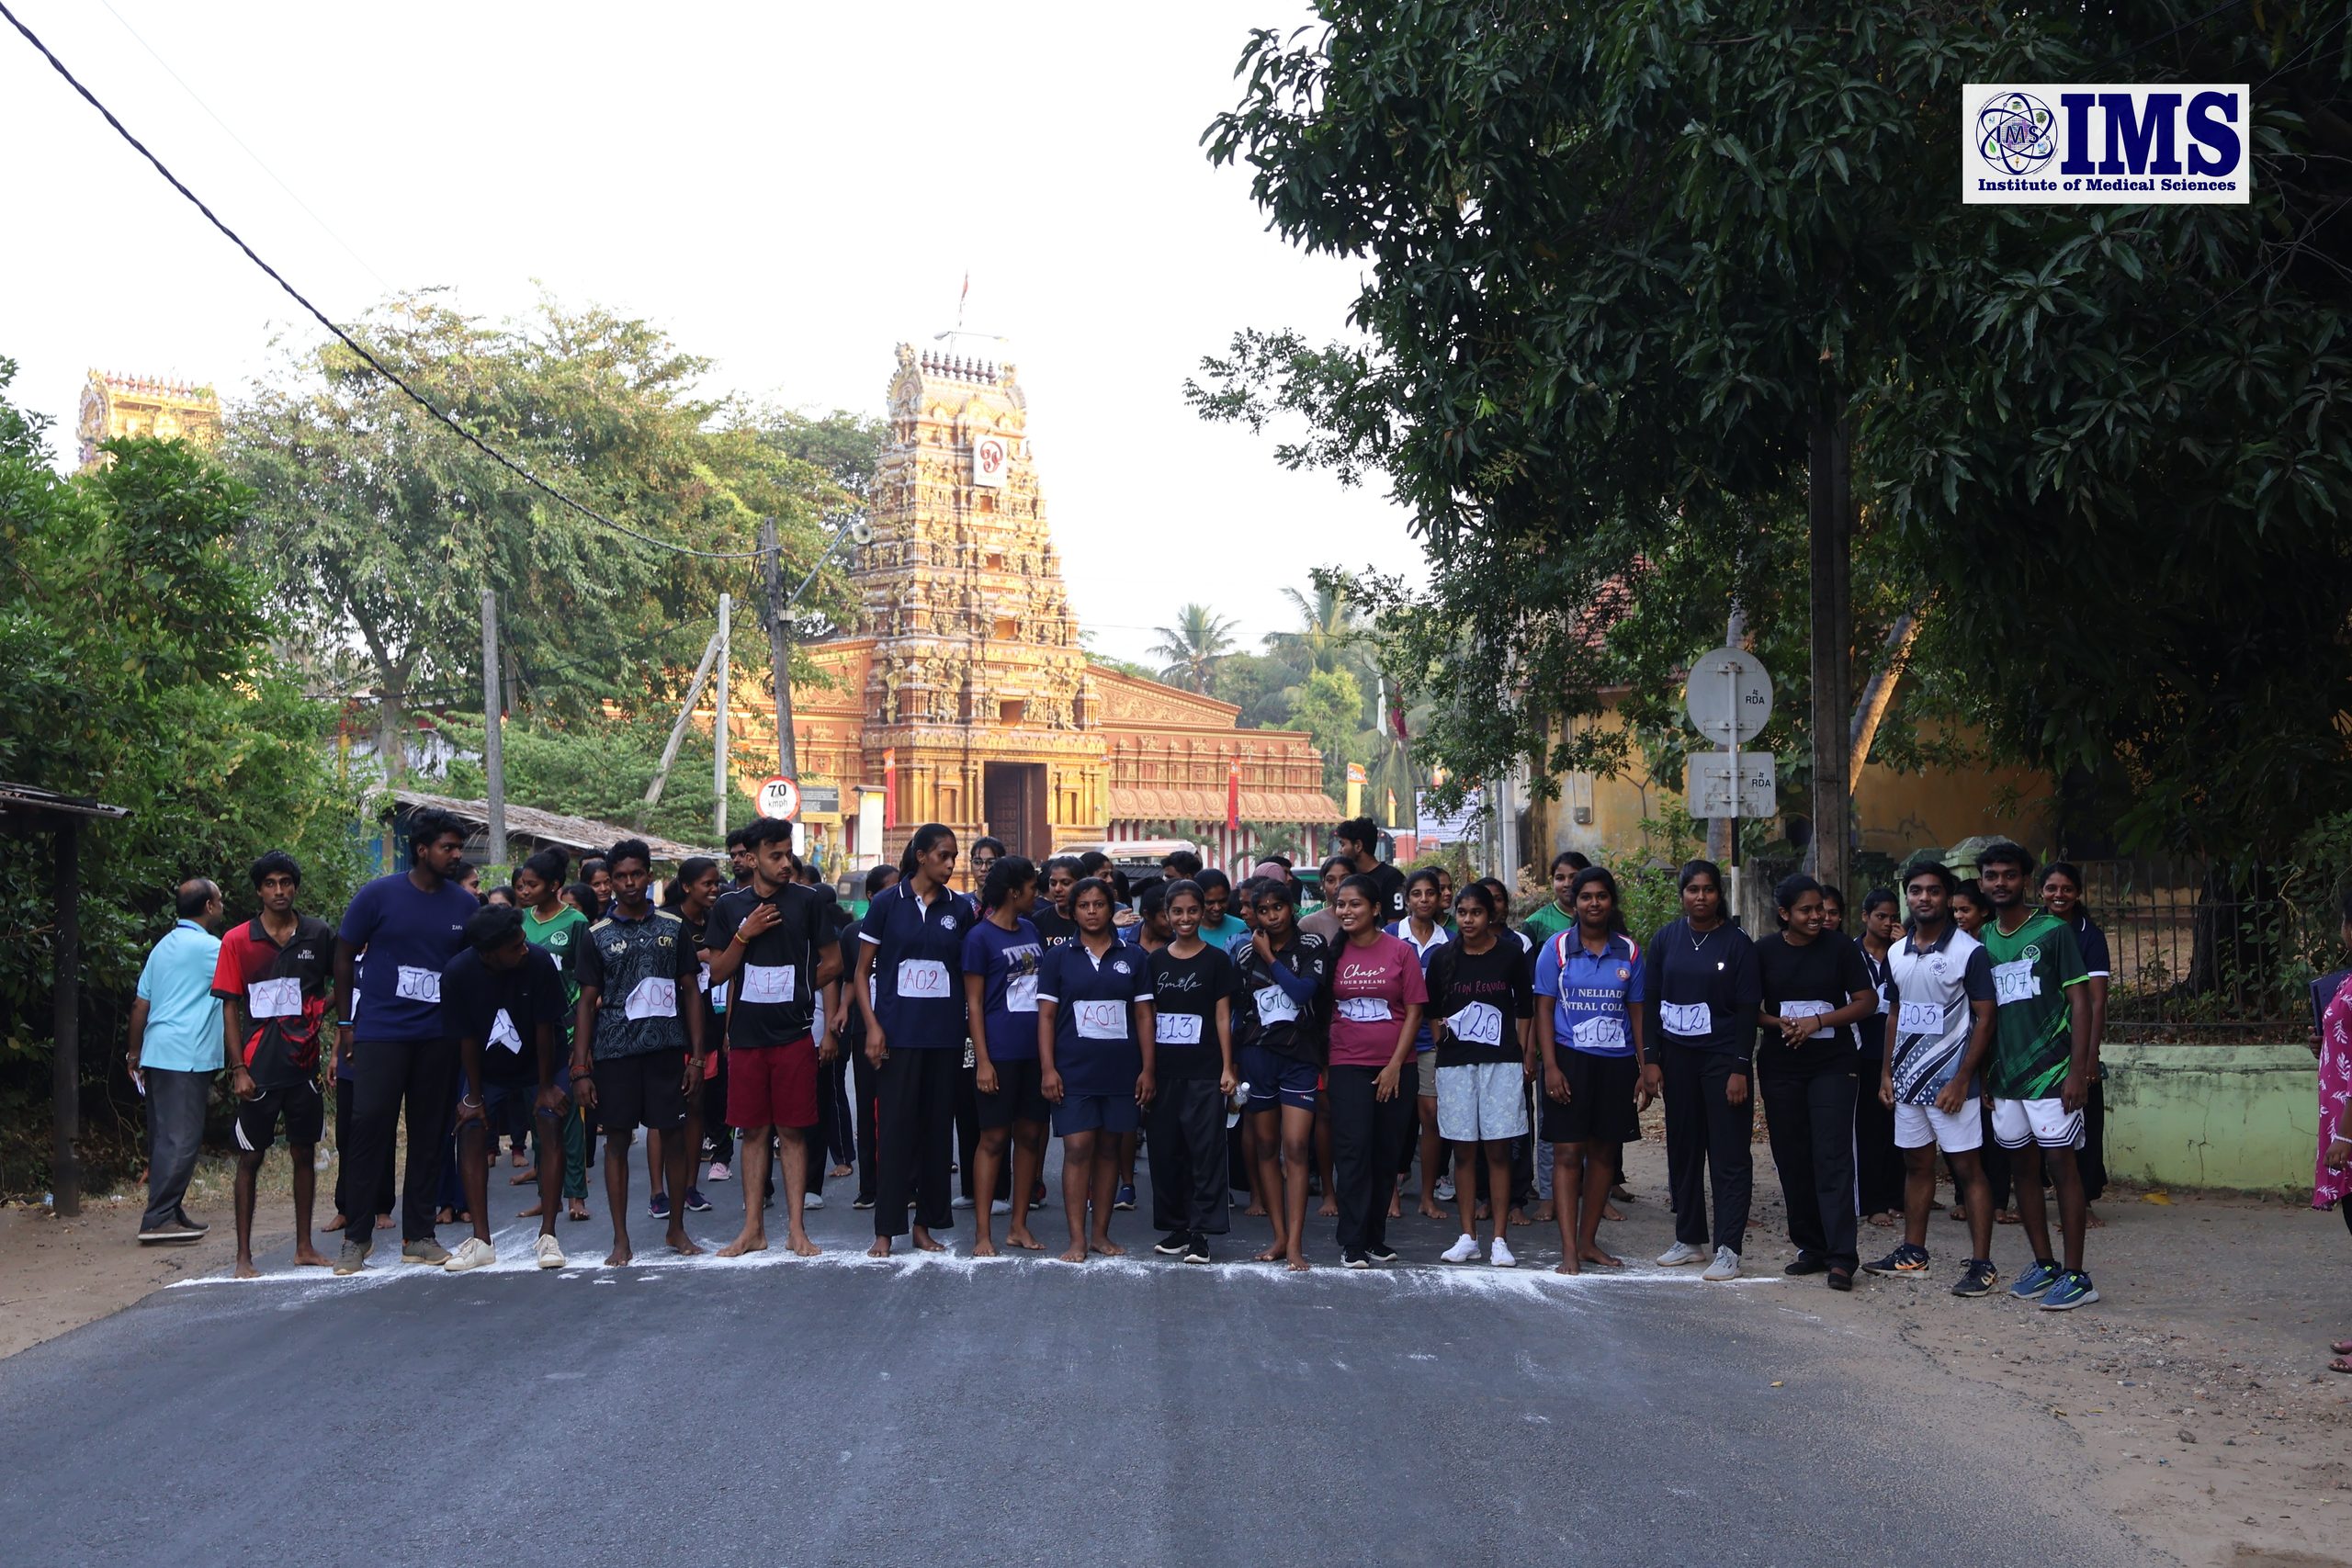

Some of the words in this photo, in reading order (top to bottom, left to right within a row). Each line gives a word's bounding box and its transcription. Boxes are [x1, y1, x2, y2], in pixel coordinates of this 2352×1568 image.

[1746, 695, 1765, 705] RDA
[768, 784, 786, 797] 70
[1751, 779, 1771, 787] RDA
[768, 799, 788, 808] kmph
[745, 969, 790, 995] A17
[903, 967, 940, 990] A02
[1158, 971, 1203, 994] Smile
[1343, 964, 1381, 979] Chase
[402, 970, 440, 999] J.0
[630, 984, 673, 1010] A08
[1082, 1005, 1119, 1027] A01
